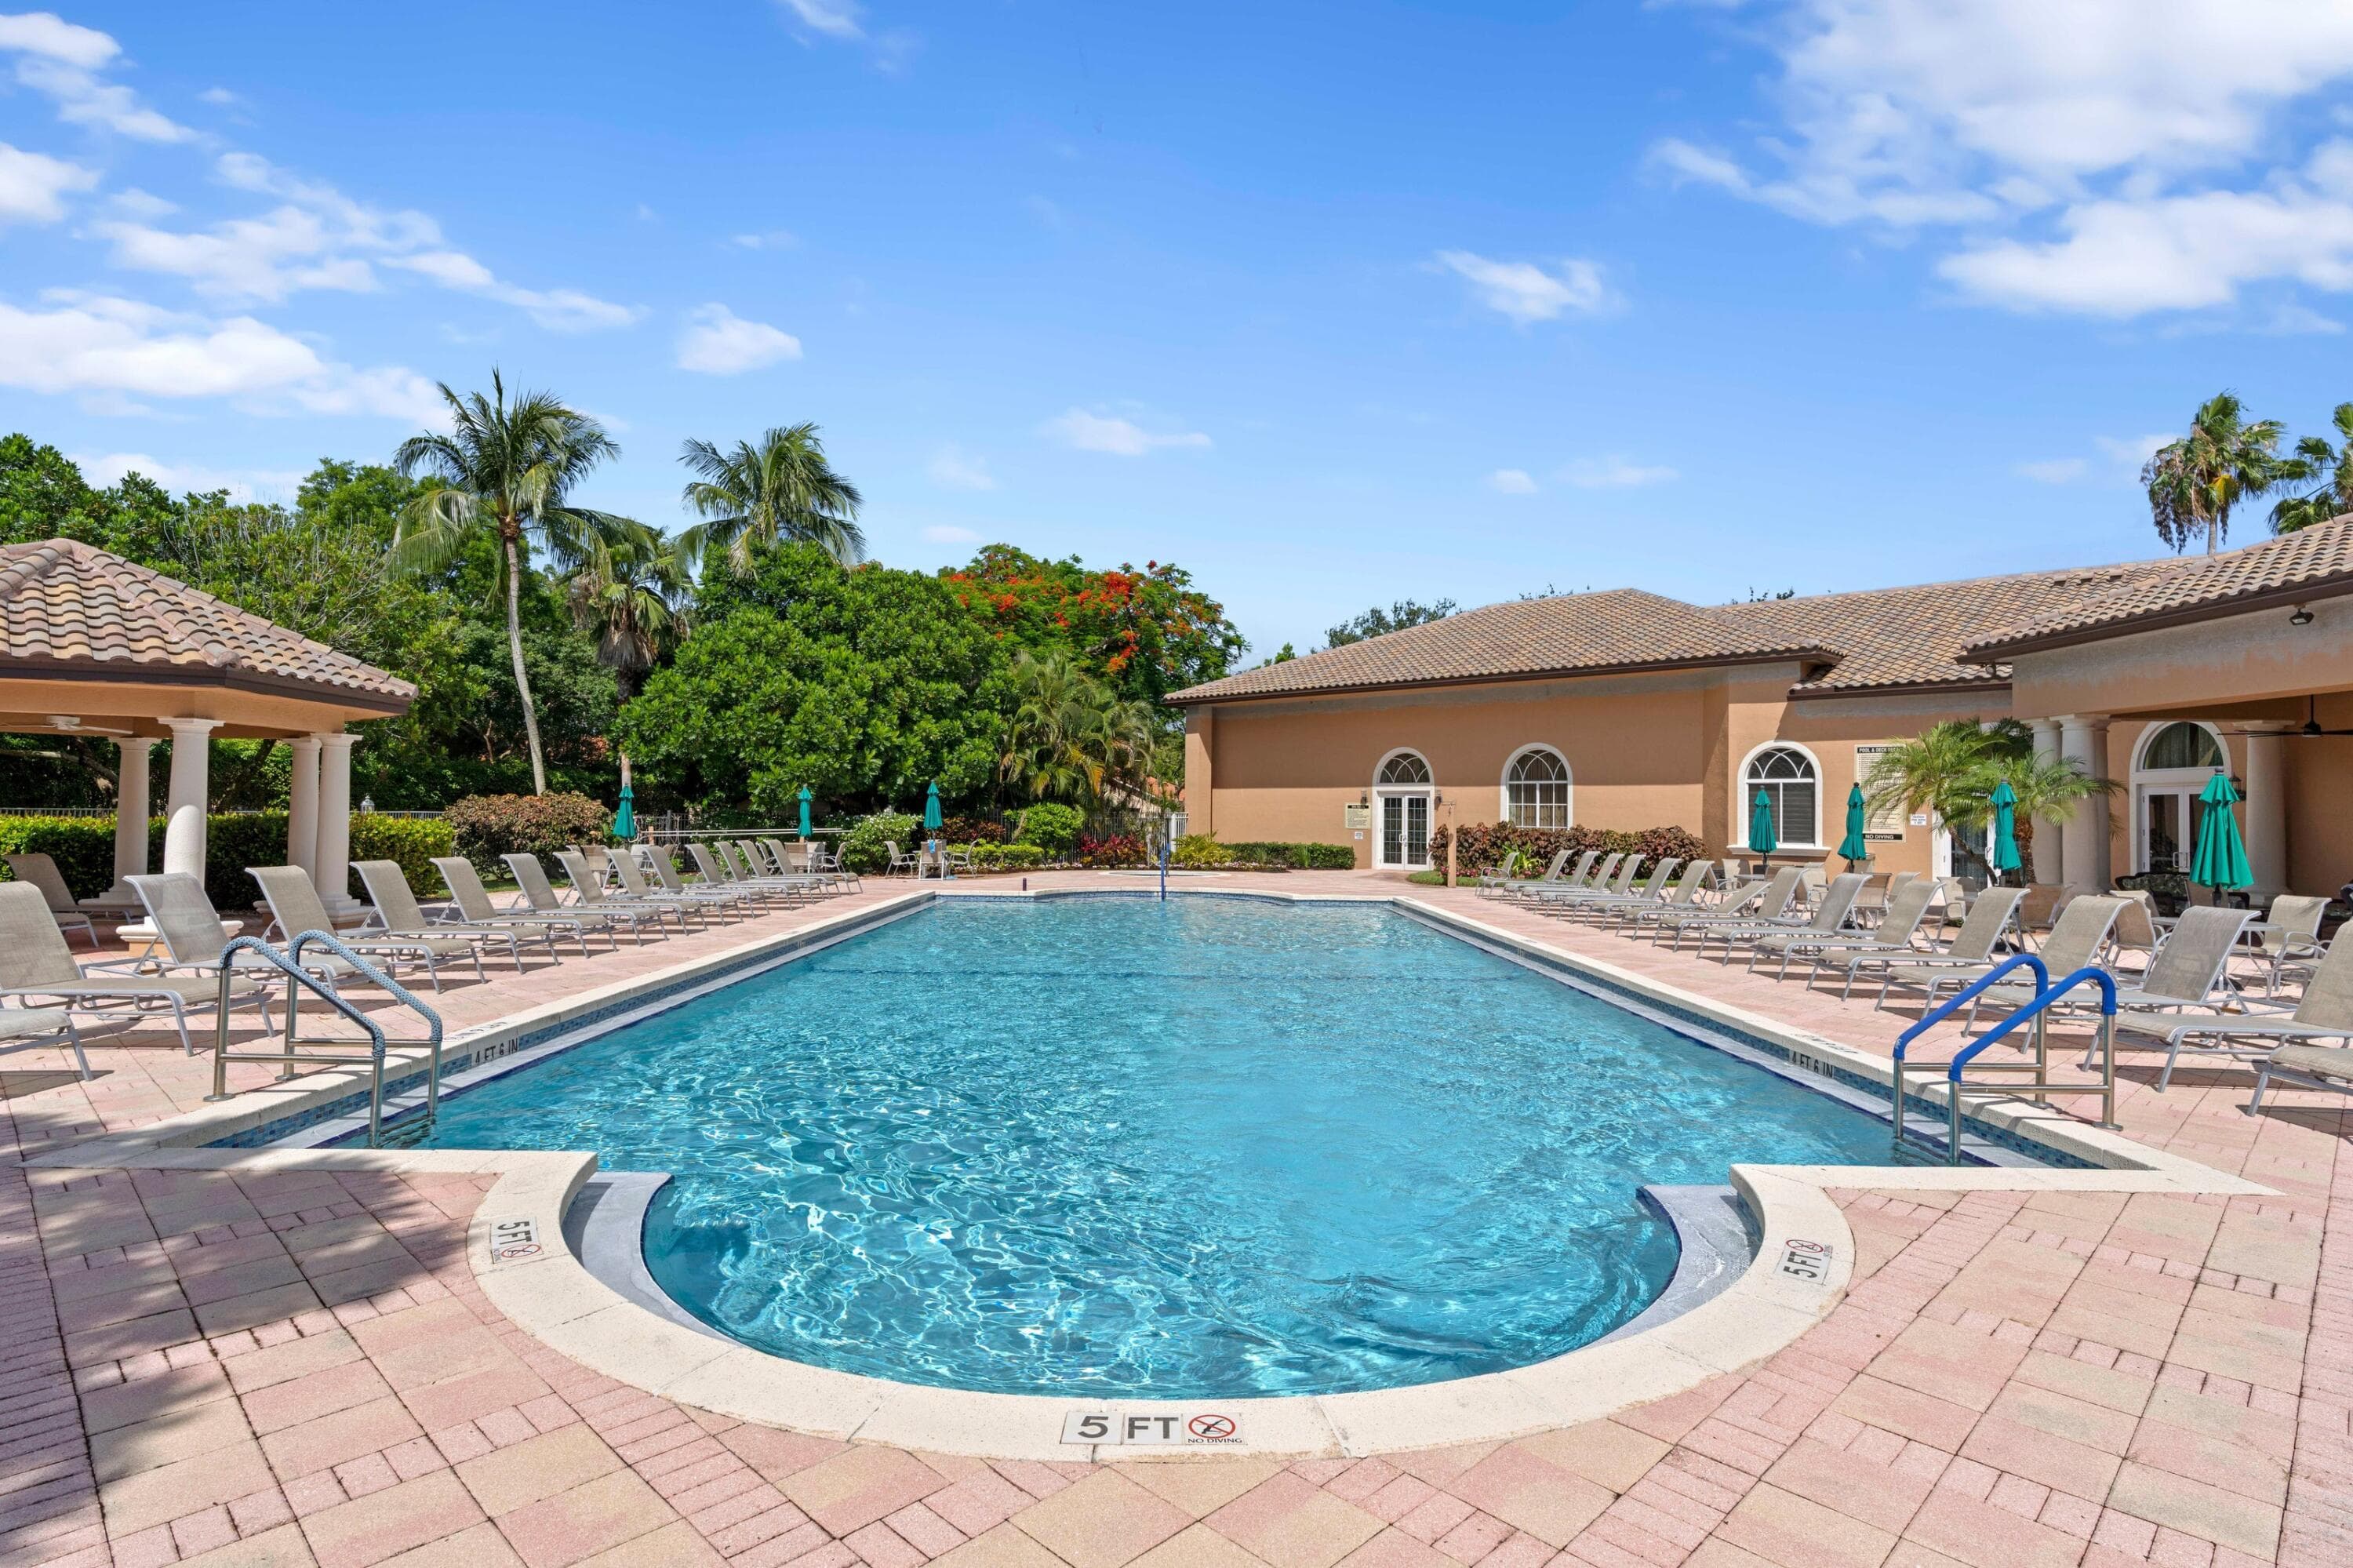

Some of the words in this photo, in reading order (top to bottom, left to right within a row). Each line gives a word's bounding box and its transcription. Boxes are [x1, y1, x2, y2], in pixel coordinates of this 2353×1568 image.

[475, 1050, 480, 1063] 4
[485, 1046, 496, 1061] FT
[499, 1042, 504, 1056] 6
[508, 1038, 518, 1054] IN
[1791, 1051, 1796, 1063] 4
[1800, 1053, 1811, 1068] FT
[1813, 1059, 1819, 1073] 6
[1823, 1061, 1833, 1078] IN
[497, 1221, 530, 1231] 5
[498, 1230, 533, 1245] FT
[1787, 1251, 1822, 1268] FT
[1783, 1266, 1818, 1279] 5
[1078, 1415, 1109, 1439] 5
[1127, 1417, 1179, 1439] FT
